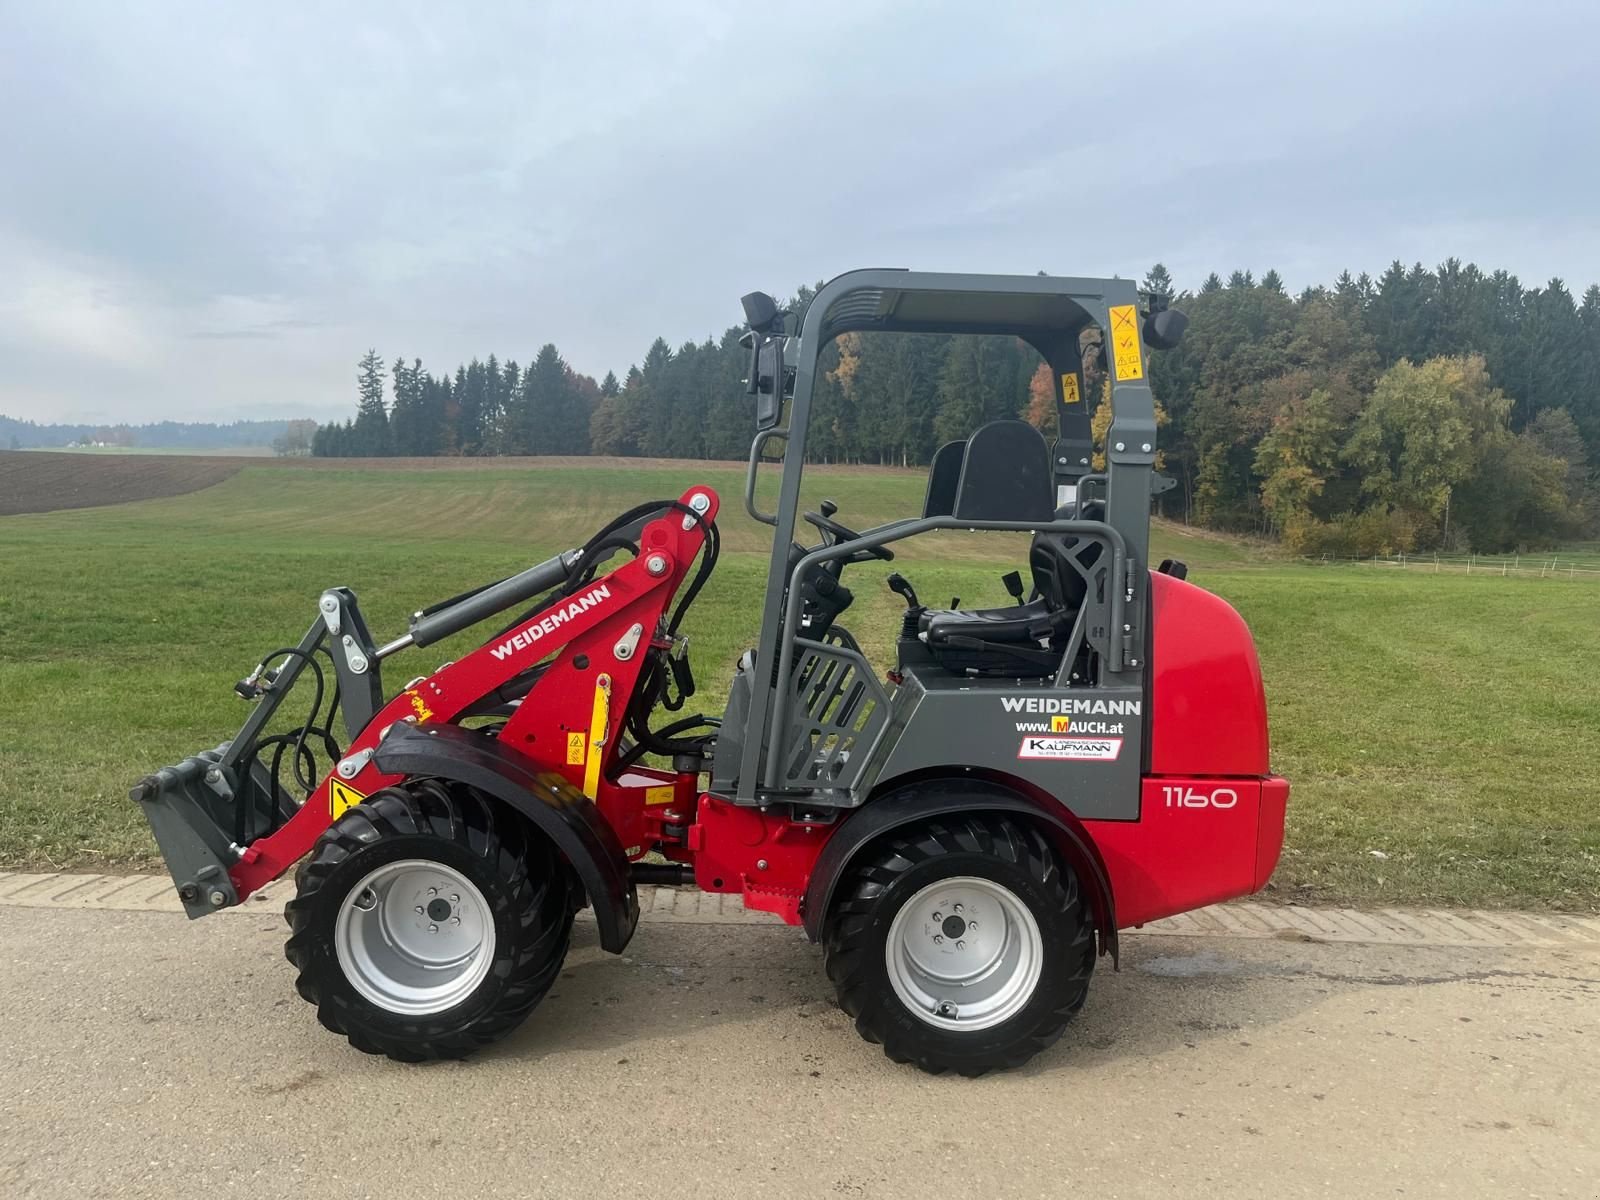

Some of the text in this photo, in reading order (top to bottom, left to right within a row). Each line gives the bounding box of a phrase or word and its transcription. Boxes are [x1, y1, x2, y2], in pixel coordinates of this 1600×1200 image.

[490, 584, 611, 660] WEIDEMANN
[1000, 697, 1141, 716] WEIDEMANN
[1015, 721, 1124, 734] www.MAUCH.at
[1162, 786, 1238, 809] 1160
